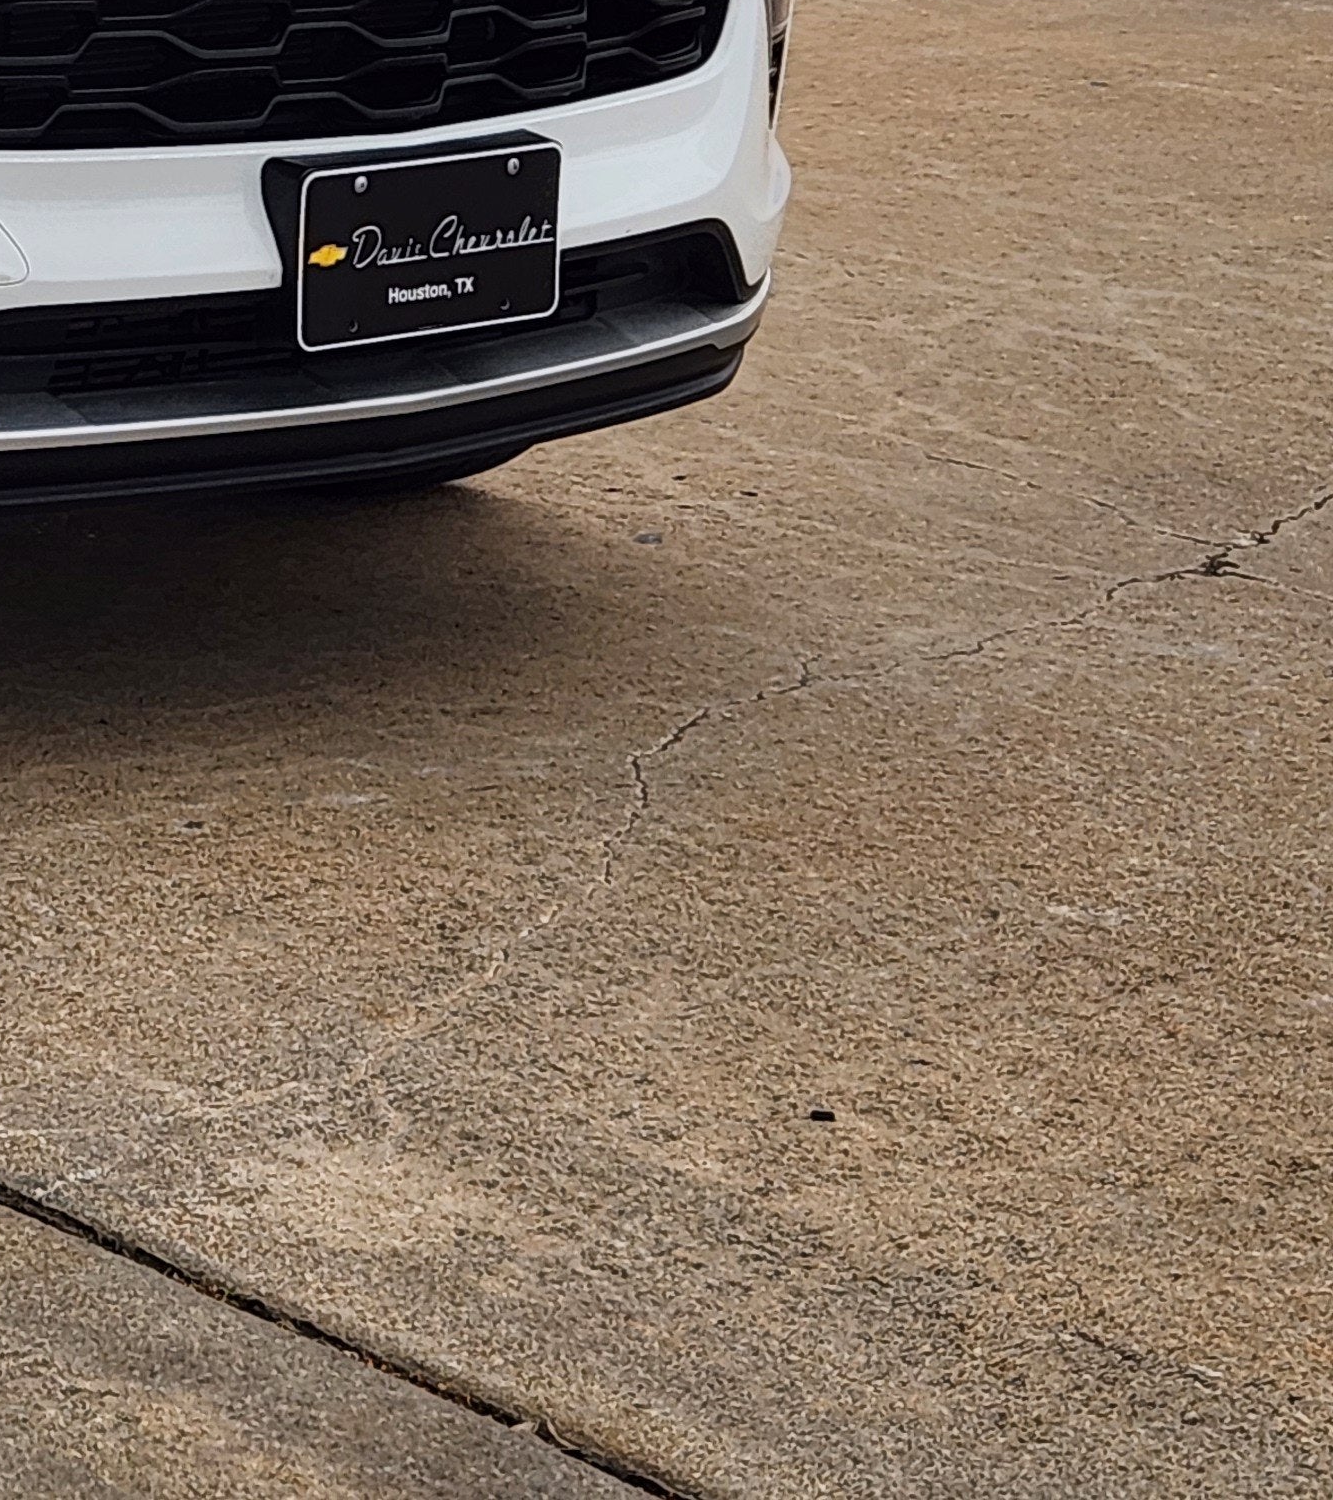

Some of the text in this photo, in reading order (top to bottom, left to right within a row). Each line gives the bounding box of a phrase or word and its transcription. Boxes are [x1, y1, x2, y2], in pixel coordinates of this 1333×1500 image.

[352, 215, 555, 268] Davis Chevrolet
[388, 276, 475, 305] Houston, TX
